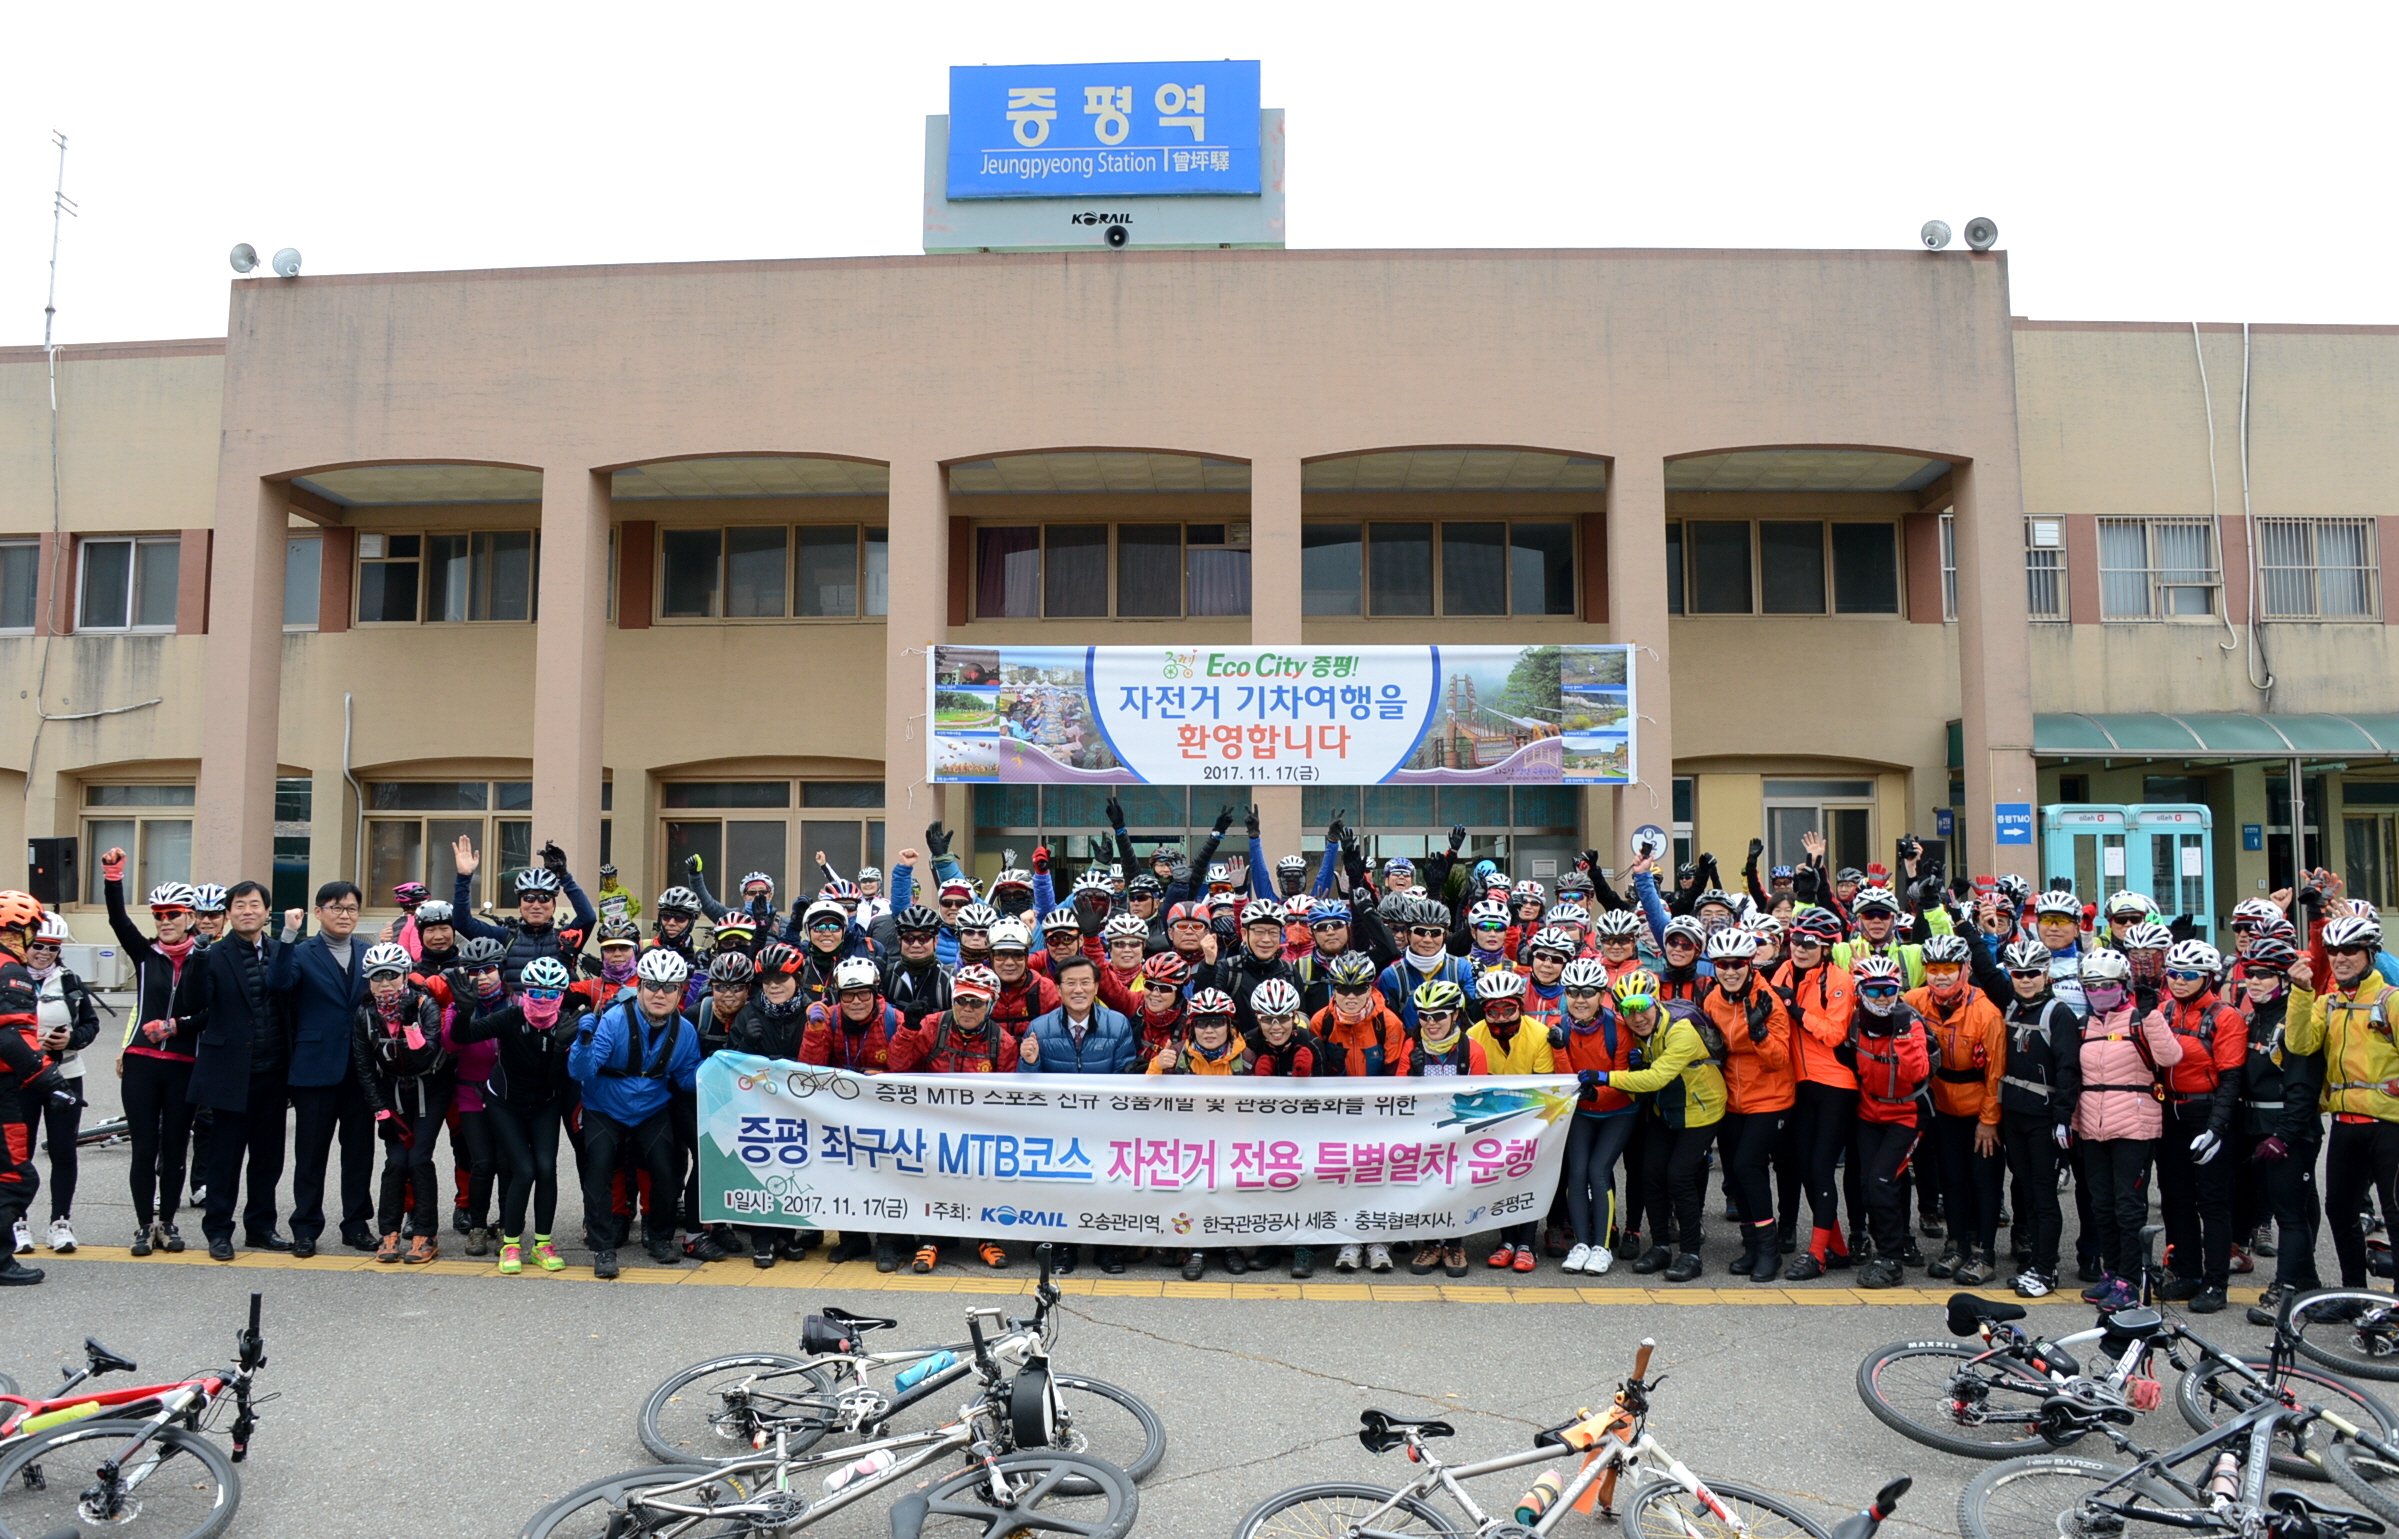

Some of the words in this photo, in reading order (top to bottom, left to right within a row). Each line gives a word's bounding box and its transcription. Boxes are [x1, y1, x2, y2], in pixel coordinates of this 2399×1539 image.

[980, 153, 1093, 179] Jeungpyeong
[1098, 151, 1156, 173] Station
[1071, 211, 1133, 226] KORAIL
[1206, 653, 1250, 678] Eco
[1255, 652, 1308, 680] City
[1311, 655, 1359, 678] 증평!
[1119, 685, 1220, 720] 자전거
[1236, 684, 1408, 721] 기차여행을
[1176, 723, 1352, 760] 환영합니다
[1203, 766, 1244, 781] 2017.
[1249, 766, 1271, 781] 11.
[1276, 765, 1320, 782] 17(금)
[875, 1083, 918, 1105] 증평
[927, 1087, 975, 1106] MTB
[983, 1089, 1048, 1107] 스포츠
[1057, 1092, 1100, 1110] 신규
[1109, 1095, 1196, 1112] 상품개발
[1206, 1098, 1225, 1113] 및
[1235, 1097, 1366, 1115] 관광상품화를
[1374, 1095, 1417, 1116] 위한
[737, 1115, 808, 1165] 증평
[820, 1124, 927, 1174] 좌구산
[938, 1132, 1093, 1179] MTB코스
[1107, 1137, 1216, 1189] 자전거
[1229, 1139, 1302, 1188] 전용
[1313, 1140, 1458, 1186] 특별열차
[1467, 1136, 1539, 1183] 운행
[734, 1191, 772, 1212] 일시:
[784, 1196, 826, 1215] 2017.
[833, 1197, 856, 1216] 11.
[863, 1198, 908, 1219] 17(금)
[932, 1202, 971, 1222] 주최:
[980, 1205, 1068, 1228] KORAIL
[1078, 1212, 1164, 1234] 오송관리역,
[1202, 1213, 1300, 1234] 한국관광공사
[1305, 1210, 1337, 1230] 세종
[1354, 1209, 1456, 1231] 충북협력지사,
[1490, 1191, 1535, 1216] 증평군
[1908, 1341, 1958, 1349] MAXXIS
[2053, 1458, 2104, 1471] BARZO
[2246, 1435, 2266, 1499] MERIDA
